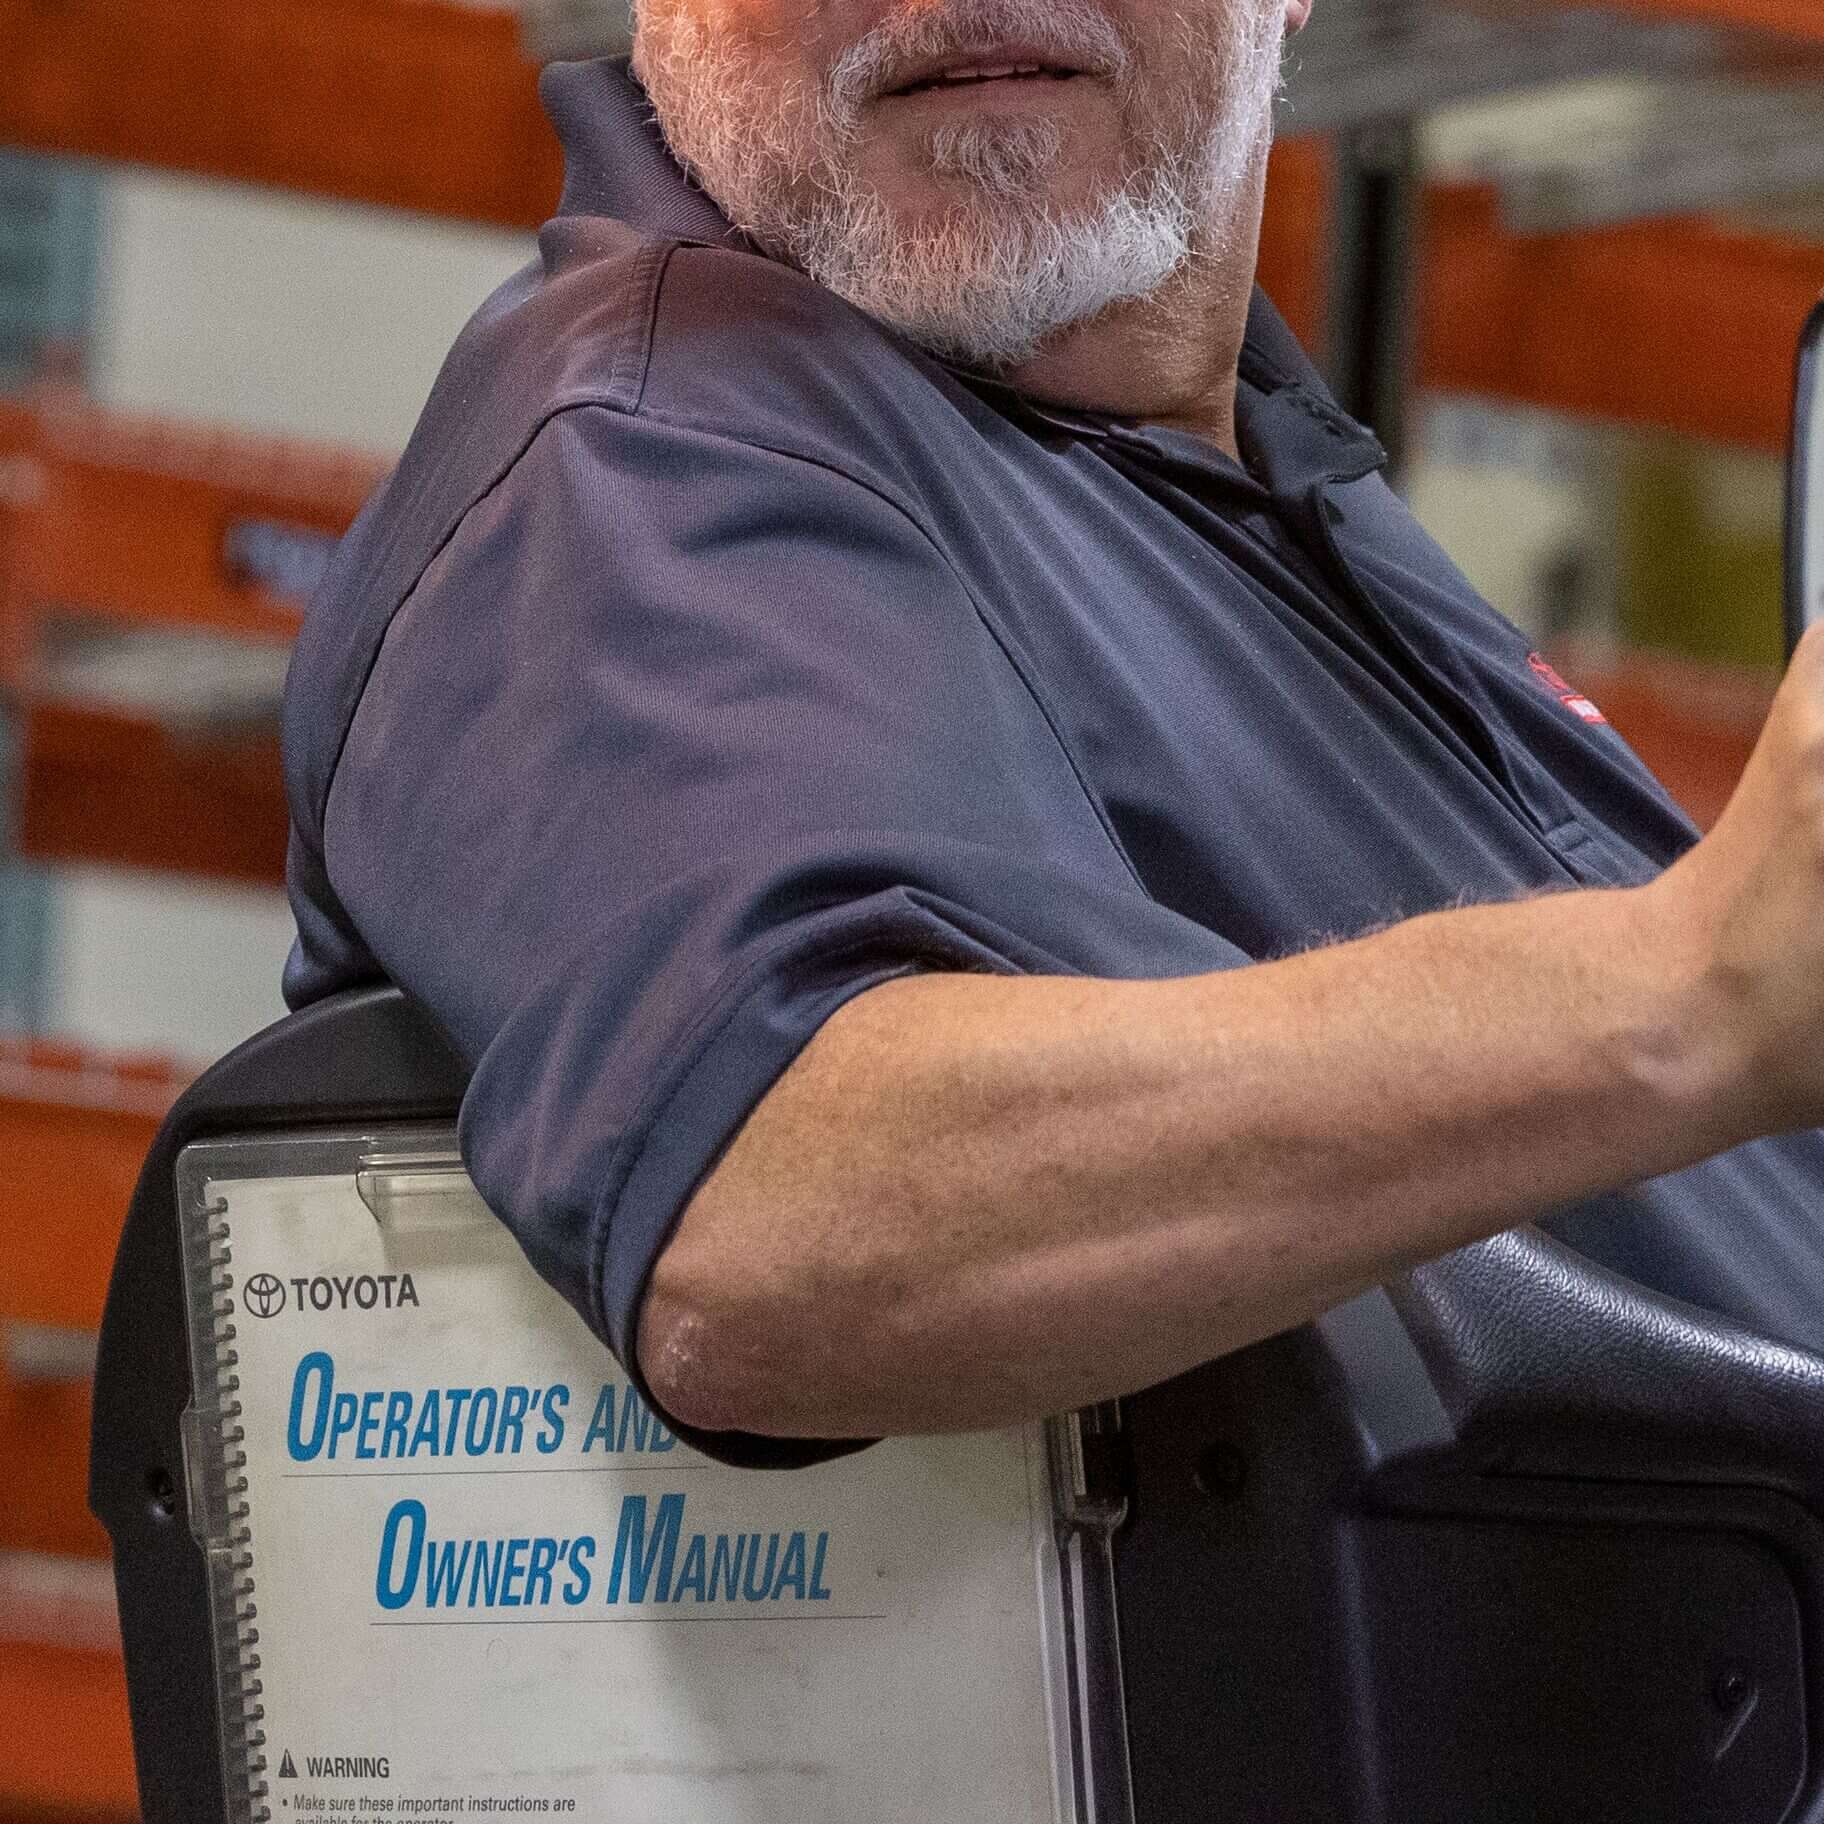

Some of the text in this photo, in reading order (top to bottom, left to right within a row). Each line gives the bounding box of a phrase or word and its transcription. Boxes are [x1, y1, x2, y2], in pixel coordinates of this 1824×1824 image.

[290, 1273, 420, 1312] TOYOTA
[287, 1351, 570, 1462] OPERATOR'S
[376, 1493, 832, 1610] OWNER'S MANUAL
[306, 1756, 390, 1778] WARNING
[293, 1793, 576, 1815] Make sure these important instructions are
